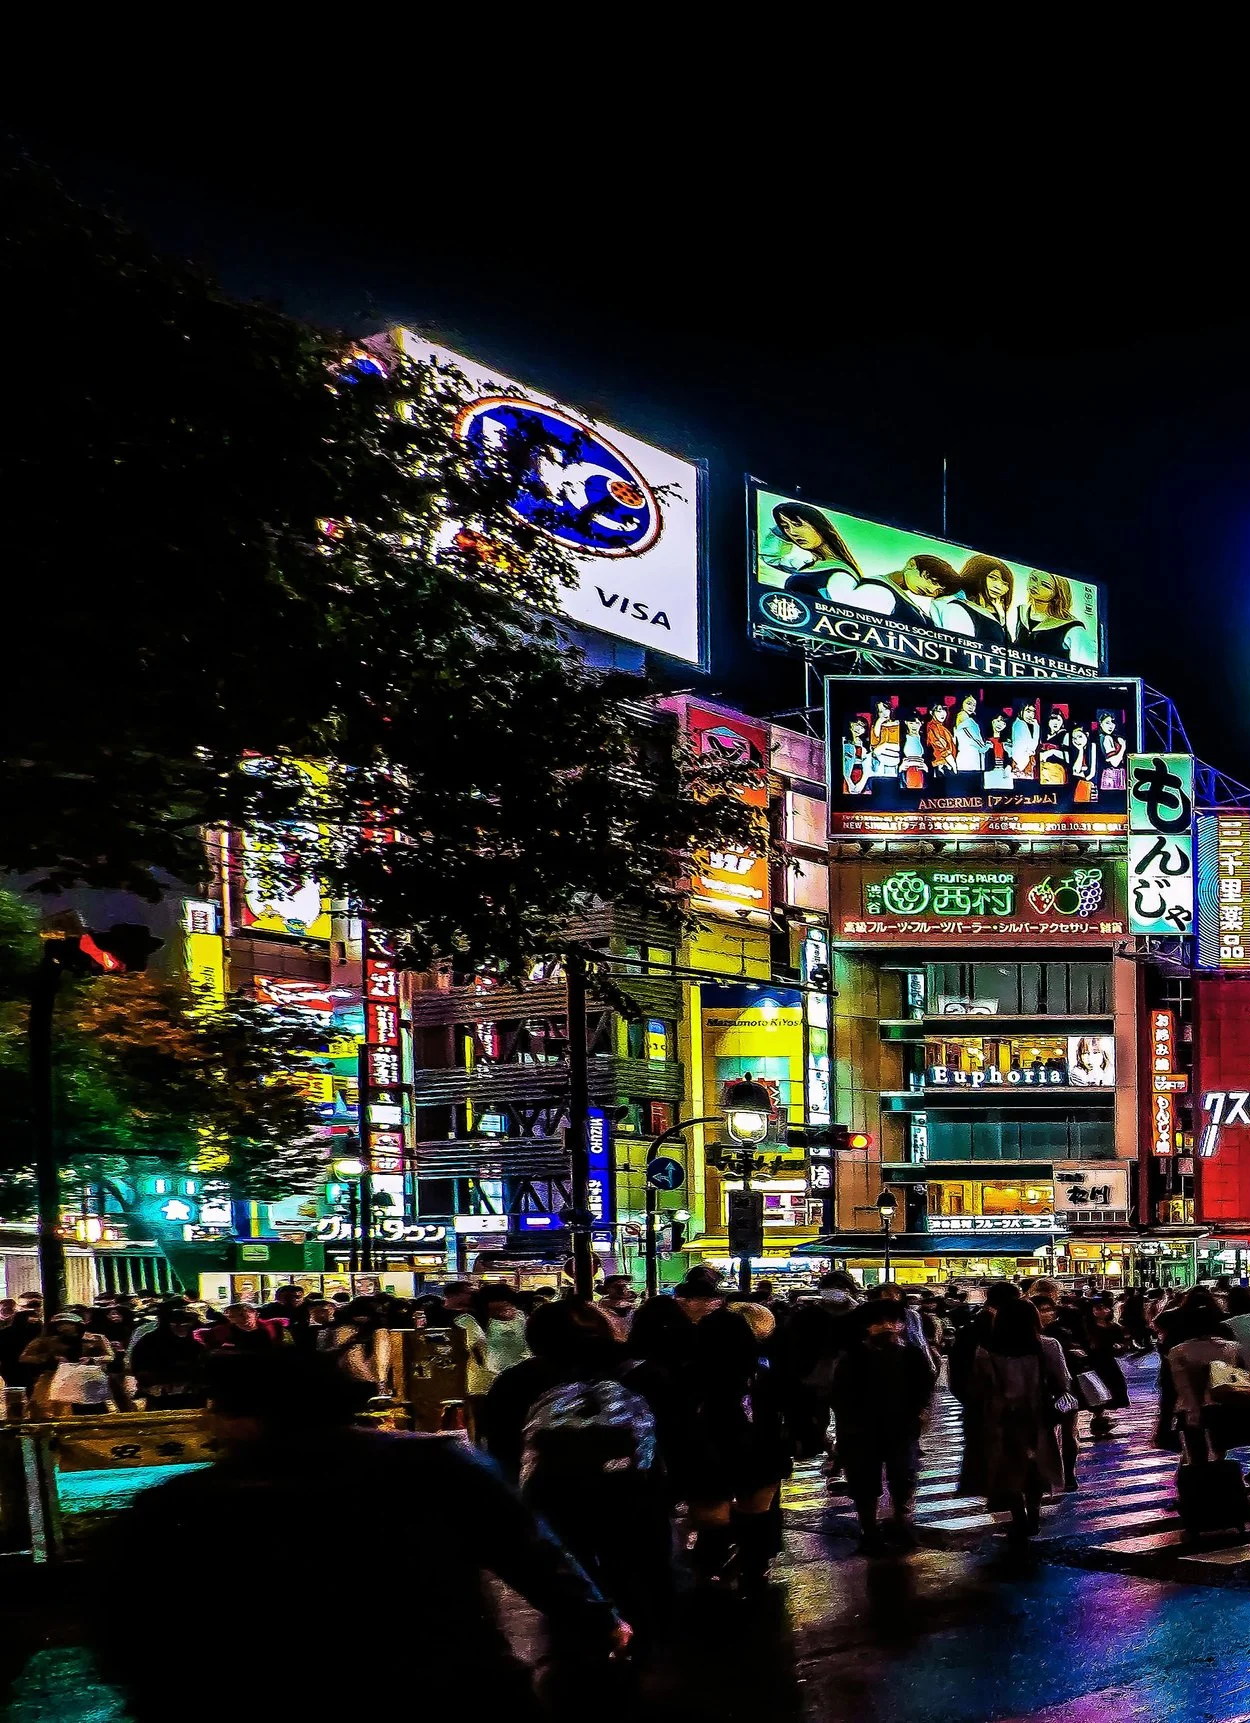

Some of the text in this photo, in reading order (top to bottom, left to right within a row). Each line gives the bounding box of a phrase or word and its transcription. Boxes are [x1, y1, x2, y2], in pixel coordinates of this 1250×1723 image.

[594, 585, 672, 630] VISA
[814, 601, 855, 619] BRAND
[856, 612, 884, 626] NEW
[885, 619, 911, 633] IDOL
[912, 626, 956, 644] SOCIETY
[1048, 659, 1099, 678] RELEASE
[963, 650, 1025, 678] THE
[918, 797, 983, 810] ANGERME
[842, 822, 862, 830] NEW
[1132, 757, 1193, 932] もんじゃ
[866, 884, 882, 914] 渋谷
[934, 886, 1015, 916] 西村
[1219, 821, 1245, 958] 三千里薬品
[933, 1065, 1062, 1089] Euphoria
[590, 1116, 604, 1154] MIZUHO
